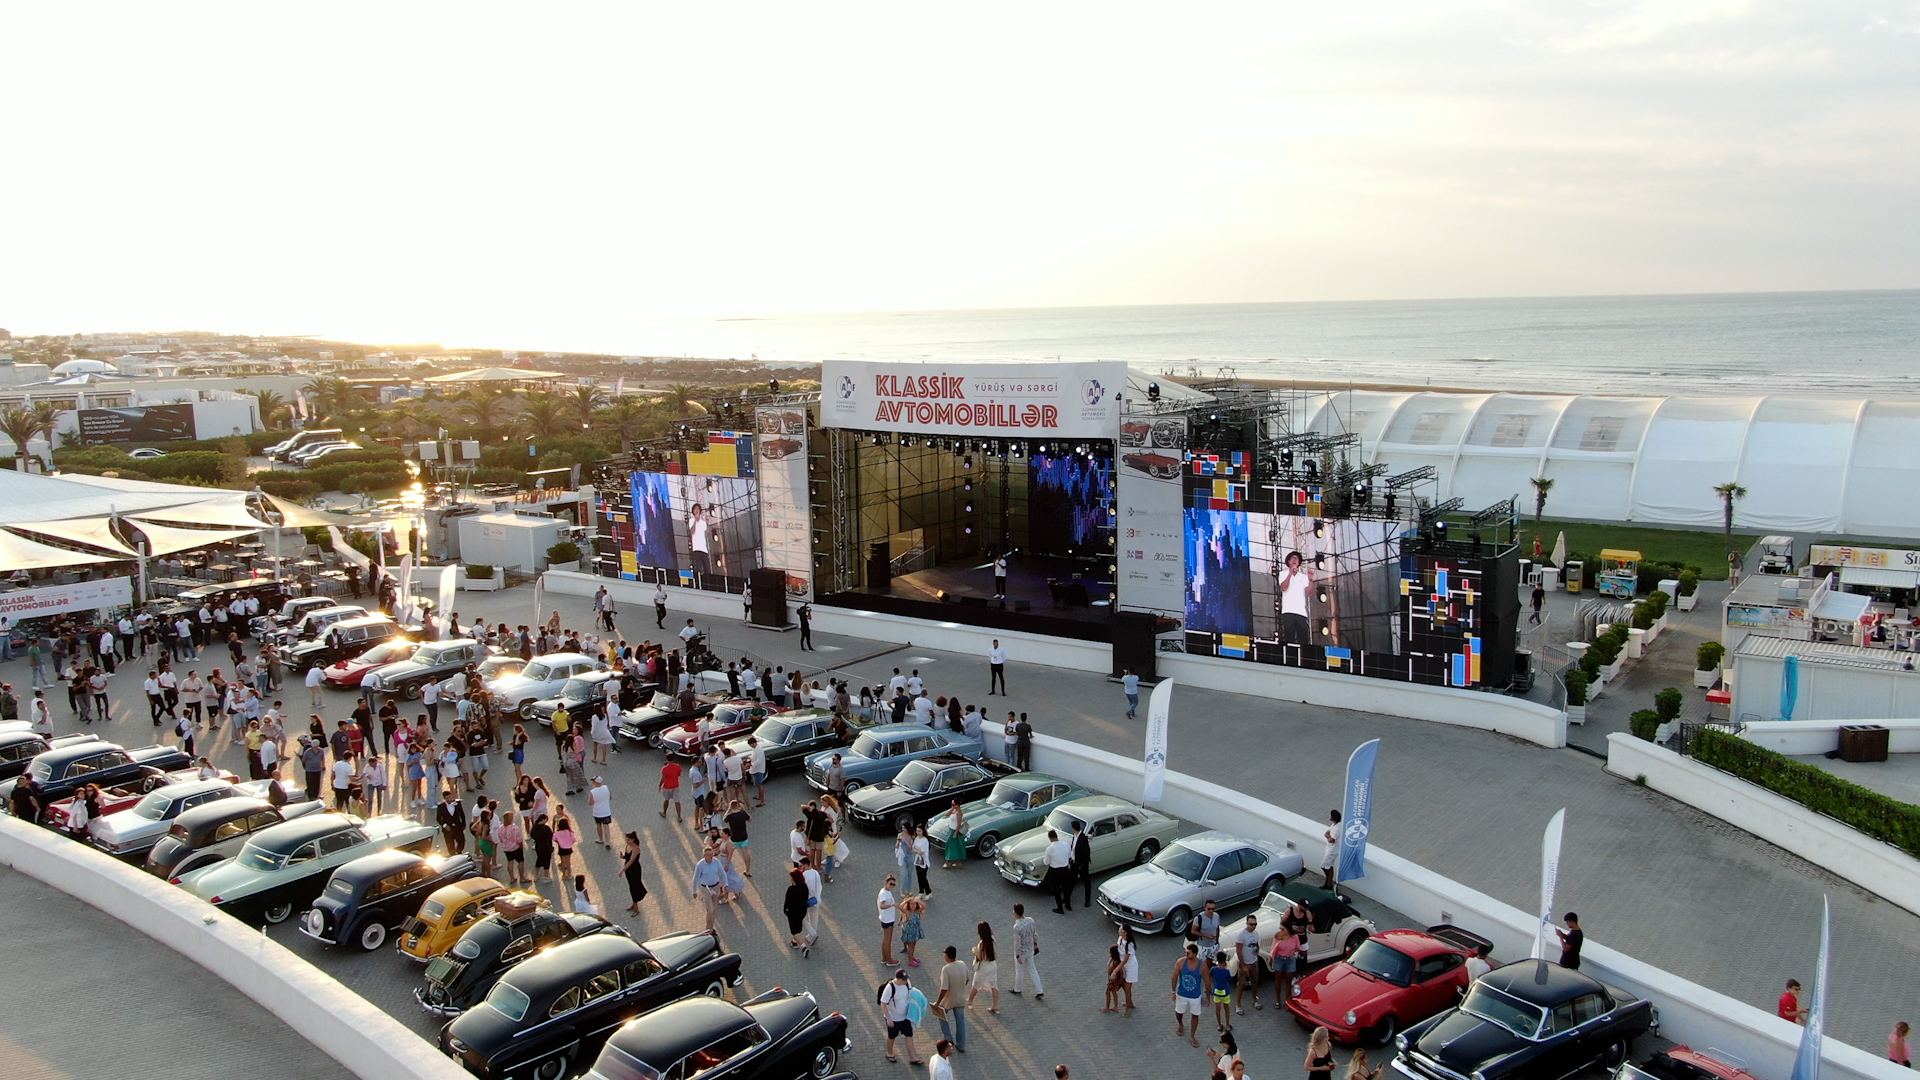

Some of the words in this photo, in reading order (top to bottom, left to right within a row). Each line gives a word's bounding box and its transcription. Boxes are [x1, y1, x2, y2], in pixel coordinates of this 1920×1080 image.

[875, 372, 965, 399] KLASSİK
[974, 382, 1005, 393] YÜRÜŞ
[1009, 384, 1023, 392] VƏ
[1027, 382, 1058, 392] SƏRGİ
[875, 400, 1058, 427] AVTOMOBİLLƏR
